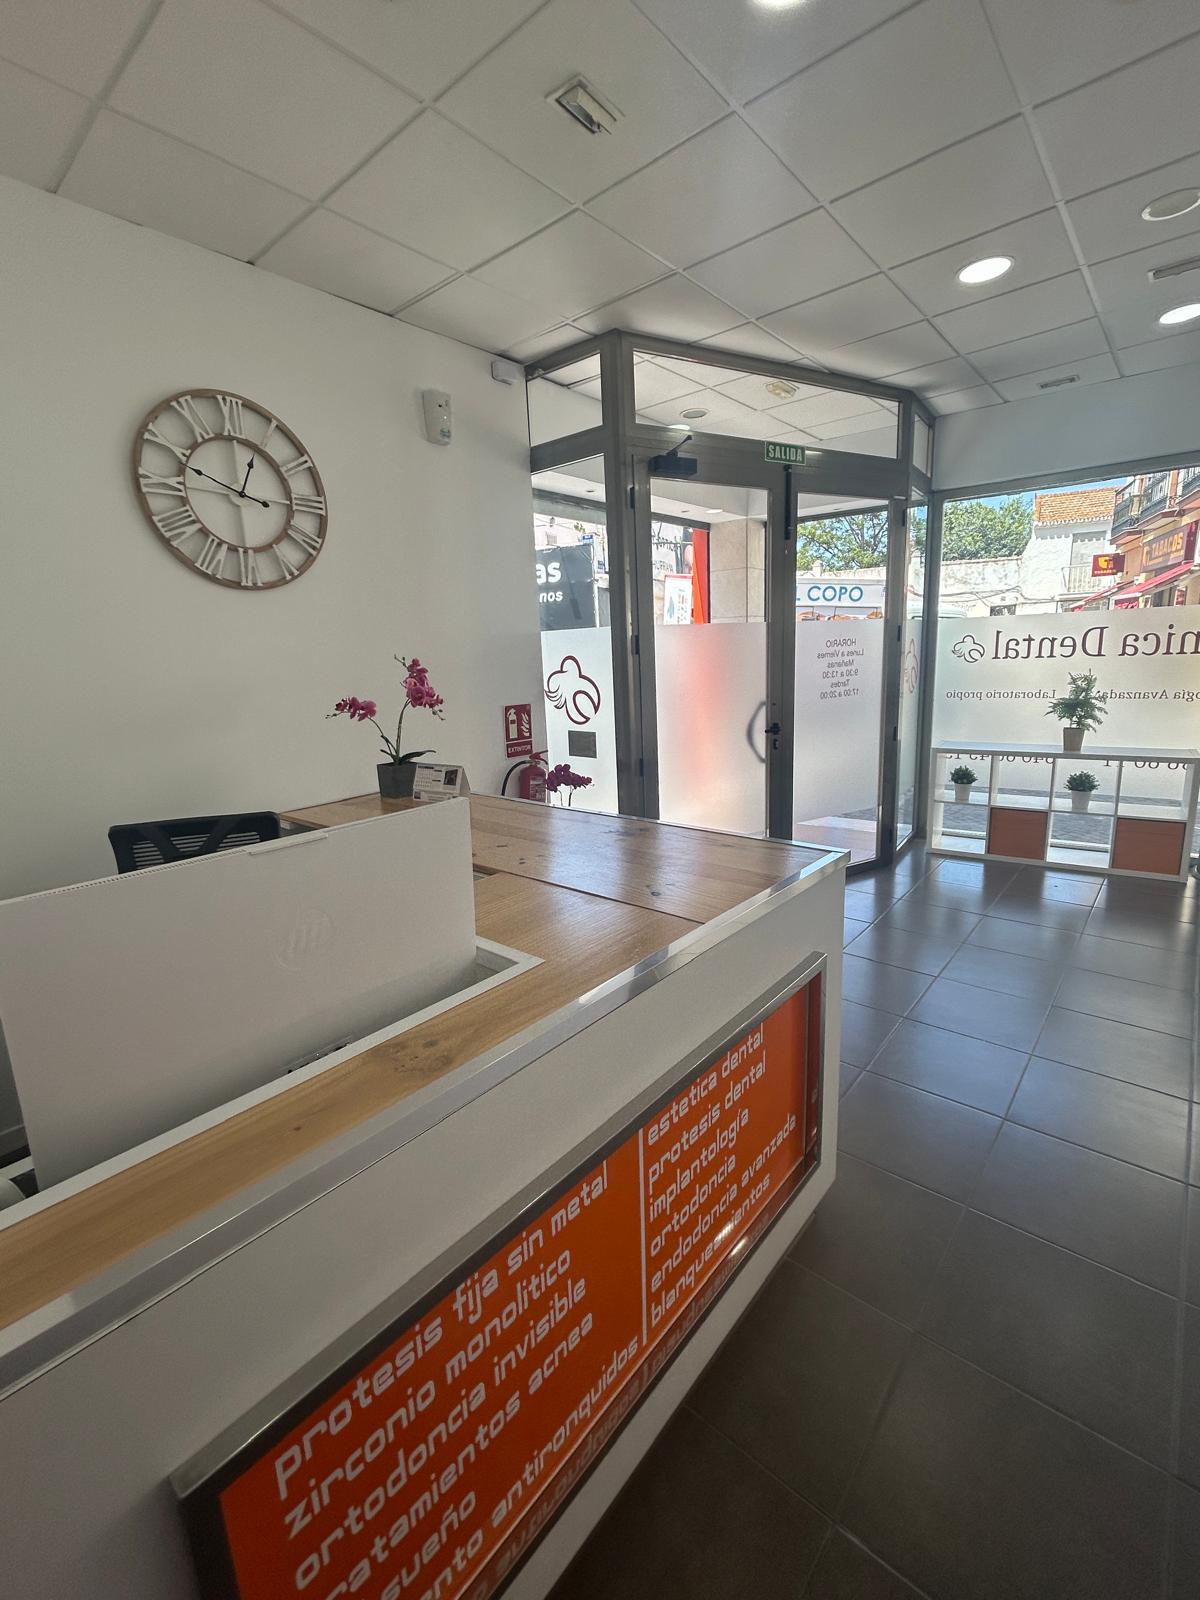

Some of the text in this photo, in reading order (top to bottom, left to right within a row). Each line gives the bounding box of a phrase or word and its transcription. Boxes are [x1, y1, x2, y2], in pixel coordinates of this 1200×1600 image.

[768, 444, 802, 461] SALIDA
[807, 585, 864, 602] COPO
[508, 745, 532, 754] EXTINTOR
[648, 1022, 764, 1146] estetica dental
[648, 1050, 766, 1195] protesis dental
[650, 1154, 736, 1257] ortodoncia
[651, 1112, 797, 1294] endodoncia avanzada
[651, 1173, 770, 1328] blanqueamientos
[274, 1160, 608, 1501] protesis fija sin metal
[284, 1249, 571, 1541] zirconio monolitico
[528, 1312, 593, 1395] acnea
[295, 1278, 586, 1590] ortodoncia invisible
[491, 1336, 639, 1528] antironquidos
